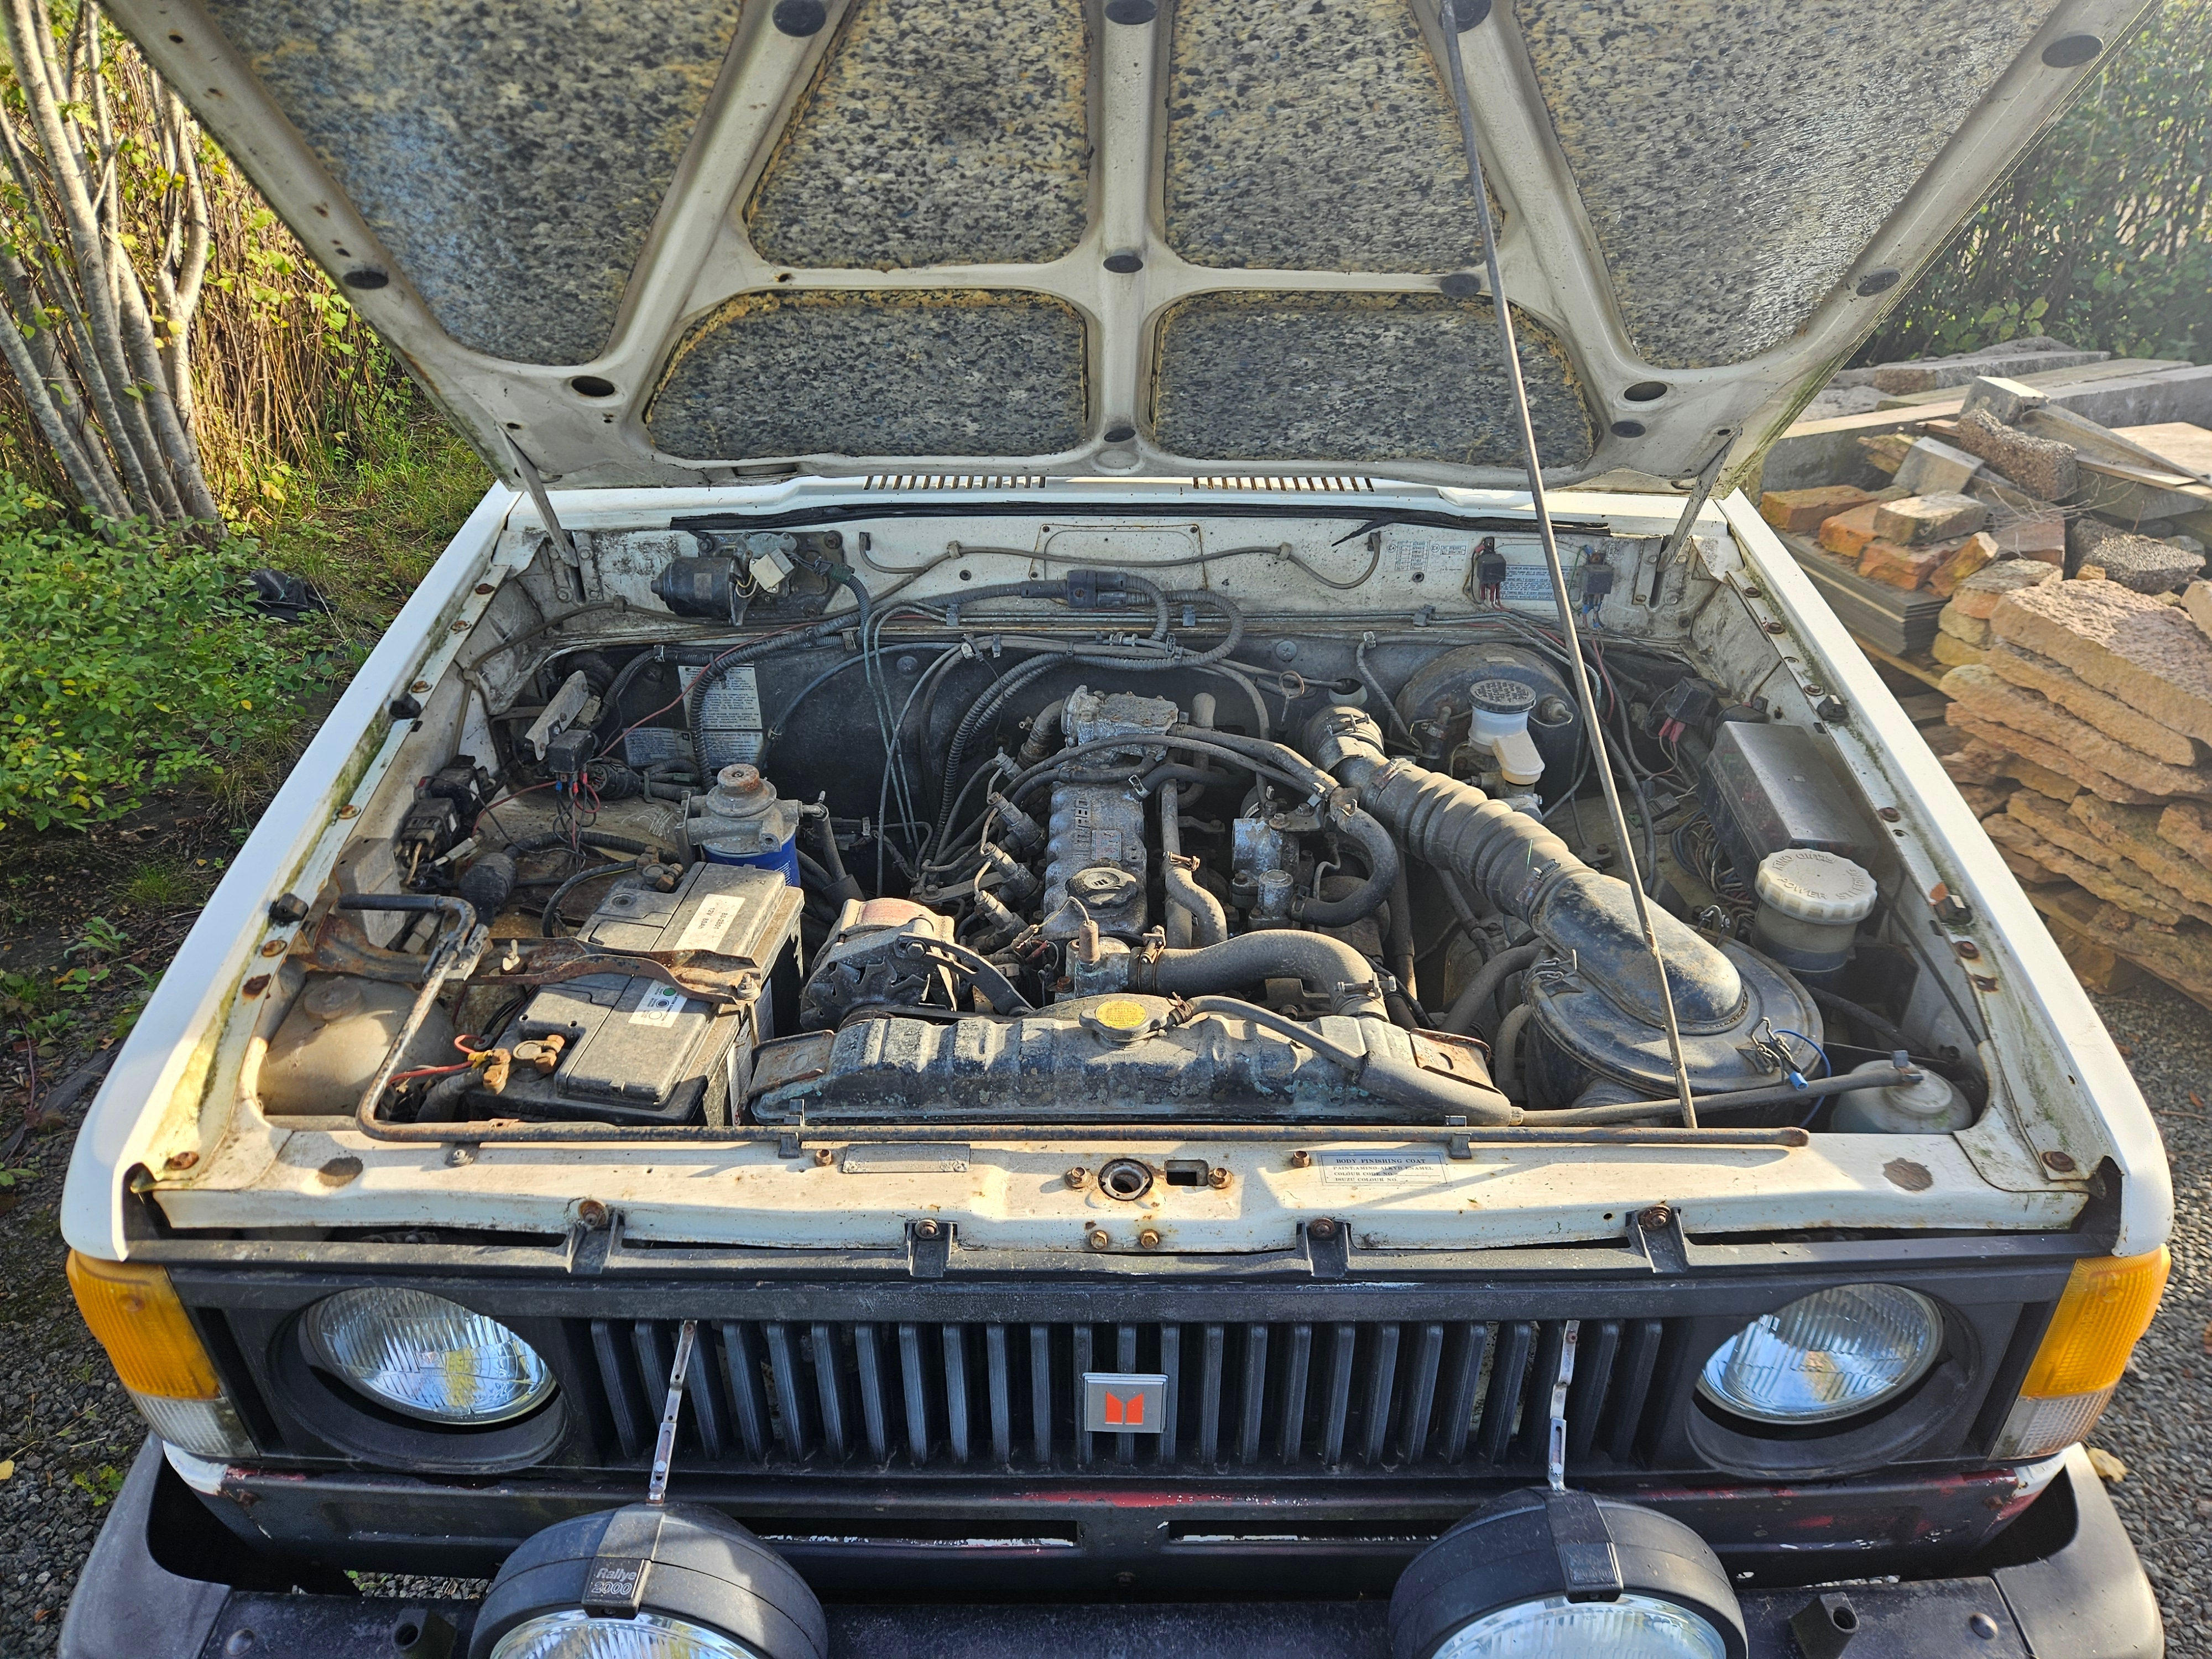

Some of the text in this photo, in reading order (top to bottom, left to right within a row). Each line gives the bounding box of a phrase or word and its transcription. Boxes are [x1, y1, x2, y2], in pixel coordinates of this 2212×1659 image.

[1772, 853, 1837, 872] ONLY FLUID
[1776, 868, 1866, 900] POWER STEERING
[706, 907, 716, 916] 12V
[596, 1567, 637, 1582] Rallye
[591, 1581, 633, 1595] 2000
